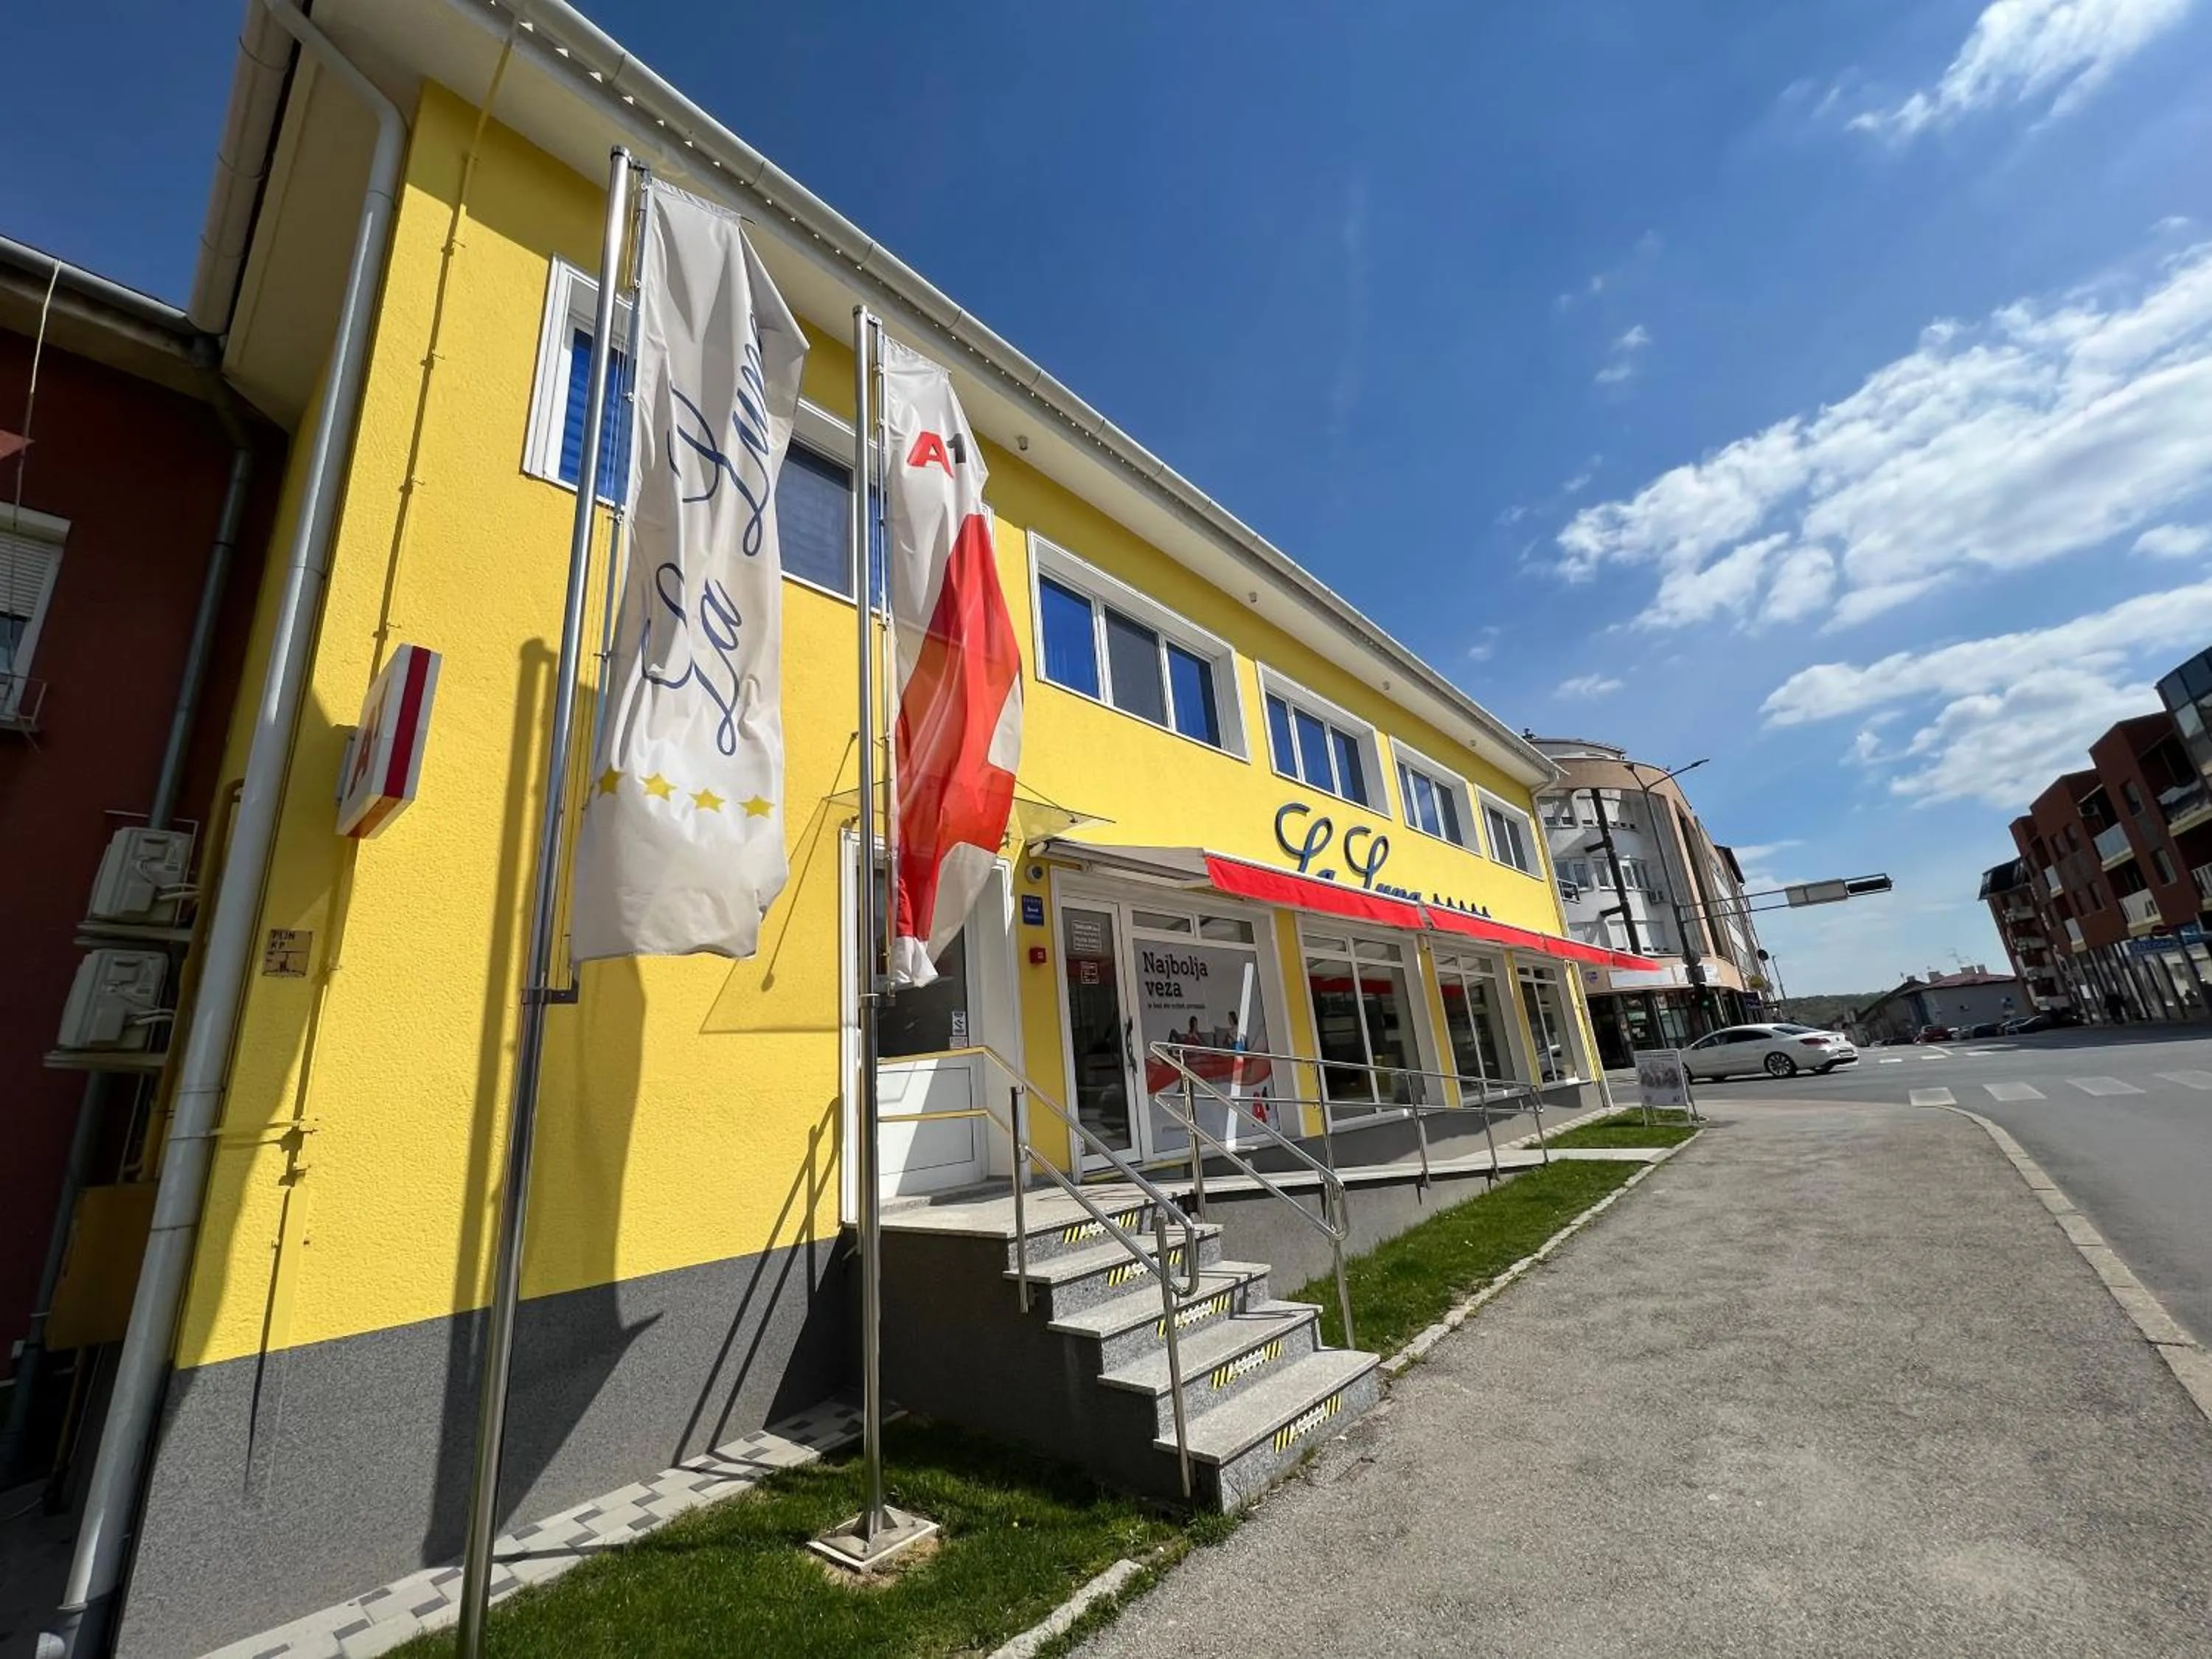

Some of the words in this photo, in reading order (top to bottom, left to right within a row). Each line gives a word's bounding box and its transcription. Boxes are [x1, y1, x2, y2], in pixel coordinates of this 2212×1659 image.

[906, 431, 967, 479] A1
[641, 563, 742, 756] La
[1142, 950, 1208, 981] Najbolja
[1144, 981, 1183, 998] veza
